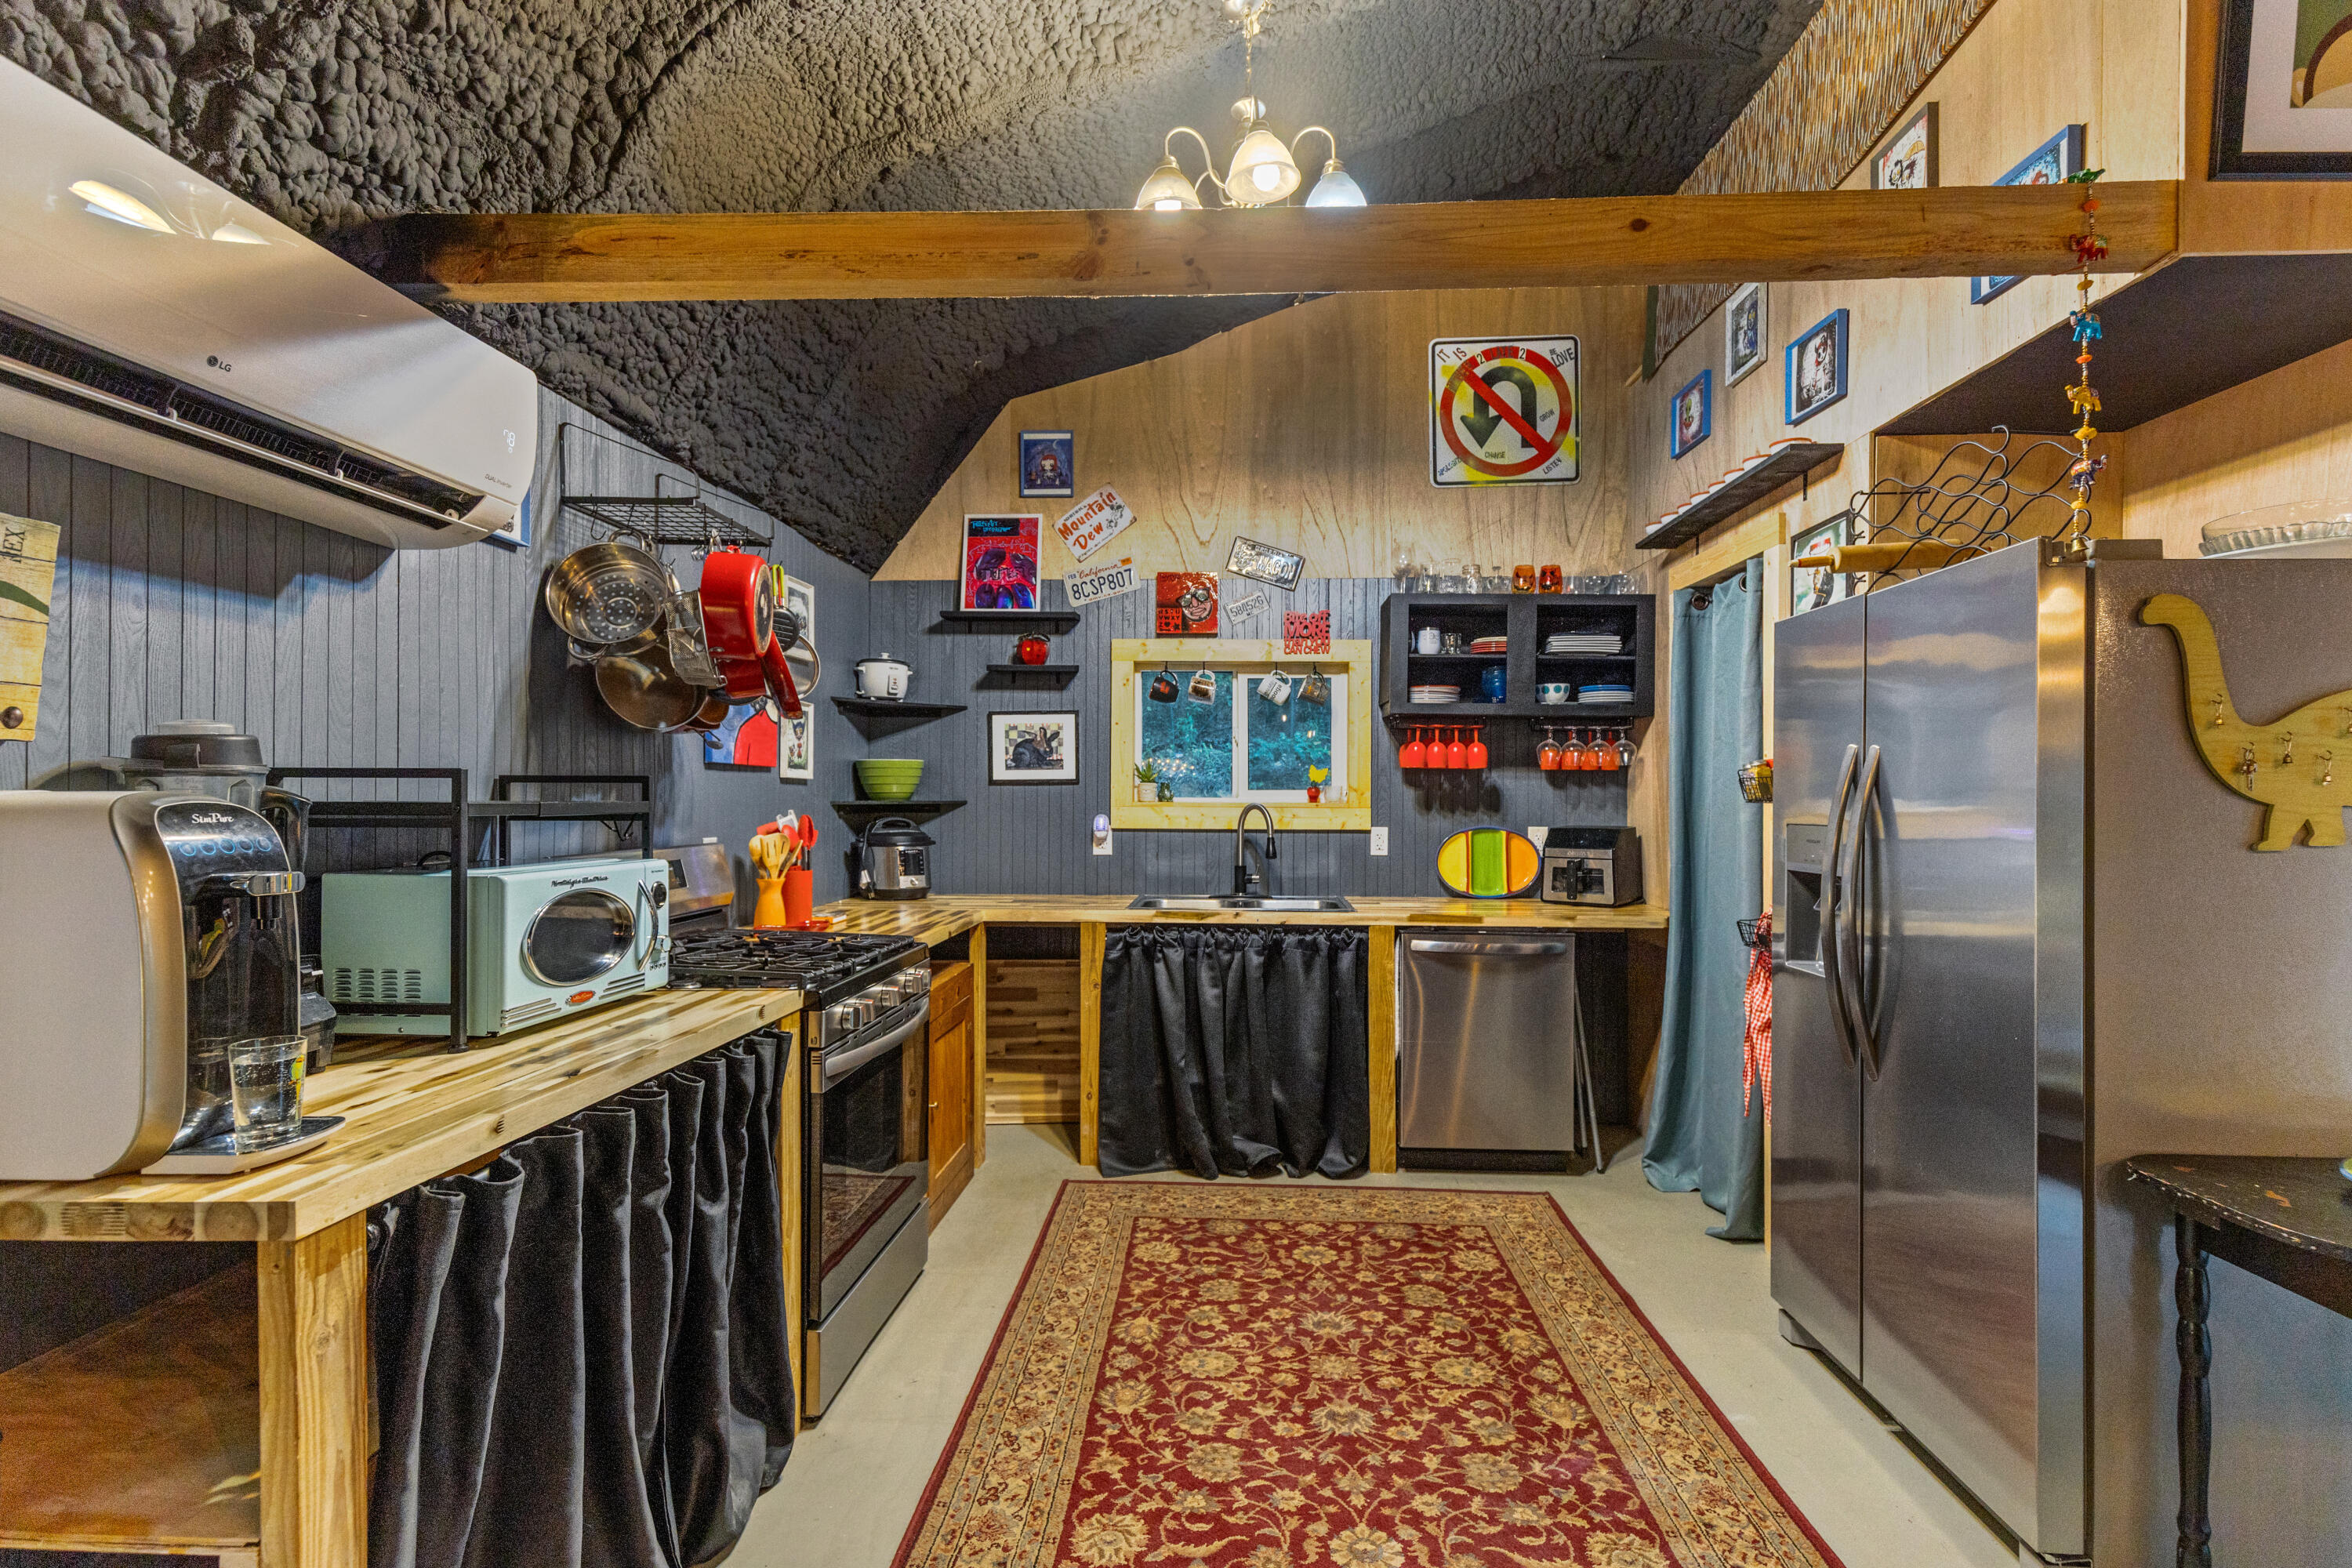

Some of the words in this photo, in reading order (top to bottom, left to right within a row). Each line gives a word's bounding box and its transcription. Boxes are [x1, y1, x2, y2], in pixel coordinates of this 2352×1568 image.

[1436, 348, 1450, 363] IT
[1453, 347, 1467, 361] IS
[1476, 353, 1486, 365] 2
[1490, 346, 1514, 360] LATE
[1519, 347, 1526, 360] 2
[1549, 347, 1558, 356] BE
[1551, 347, 1575, 368] LOVE
[219, 361, 232, 372] LG
[1539, 408, 1555, 423] GROW
[1542, 456, 1563, 475] LISTEN
[1073, 521, 1104, 550] Dew
[1079, 564, 1121, 580] California
[1256, 554, 1296, 580] MACON
[1071, 568, 1132, 601] 8CSP807
[1284, 621, 1331, 637] MORE
[1284, 645, 1302, 655] CAN
[1303, 645, 1331, 655] CHEW
[191, 812, 234, 824] SimPure
